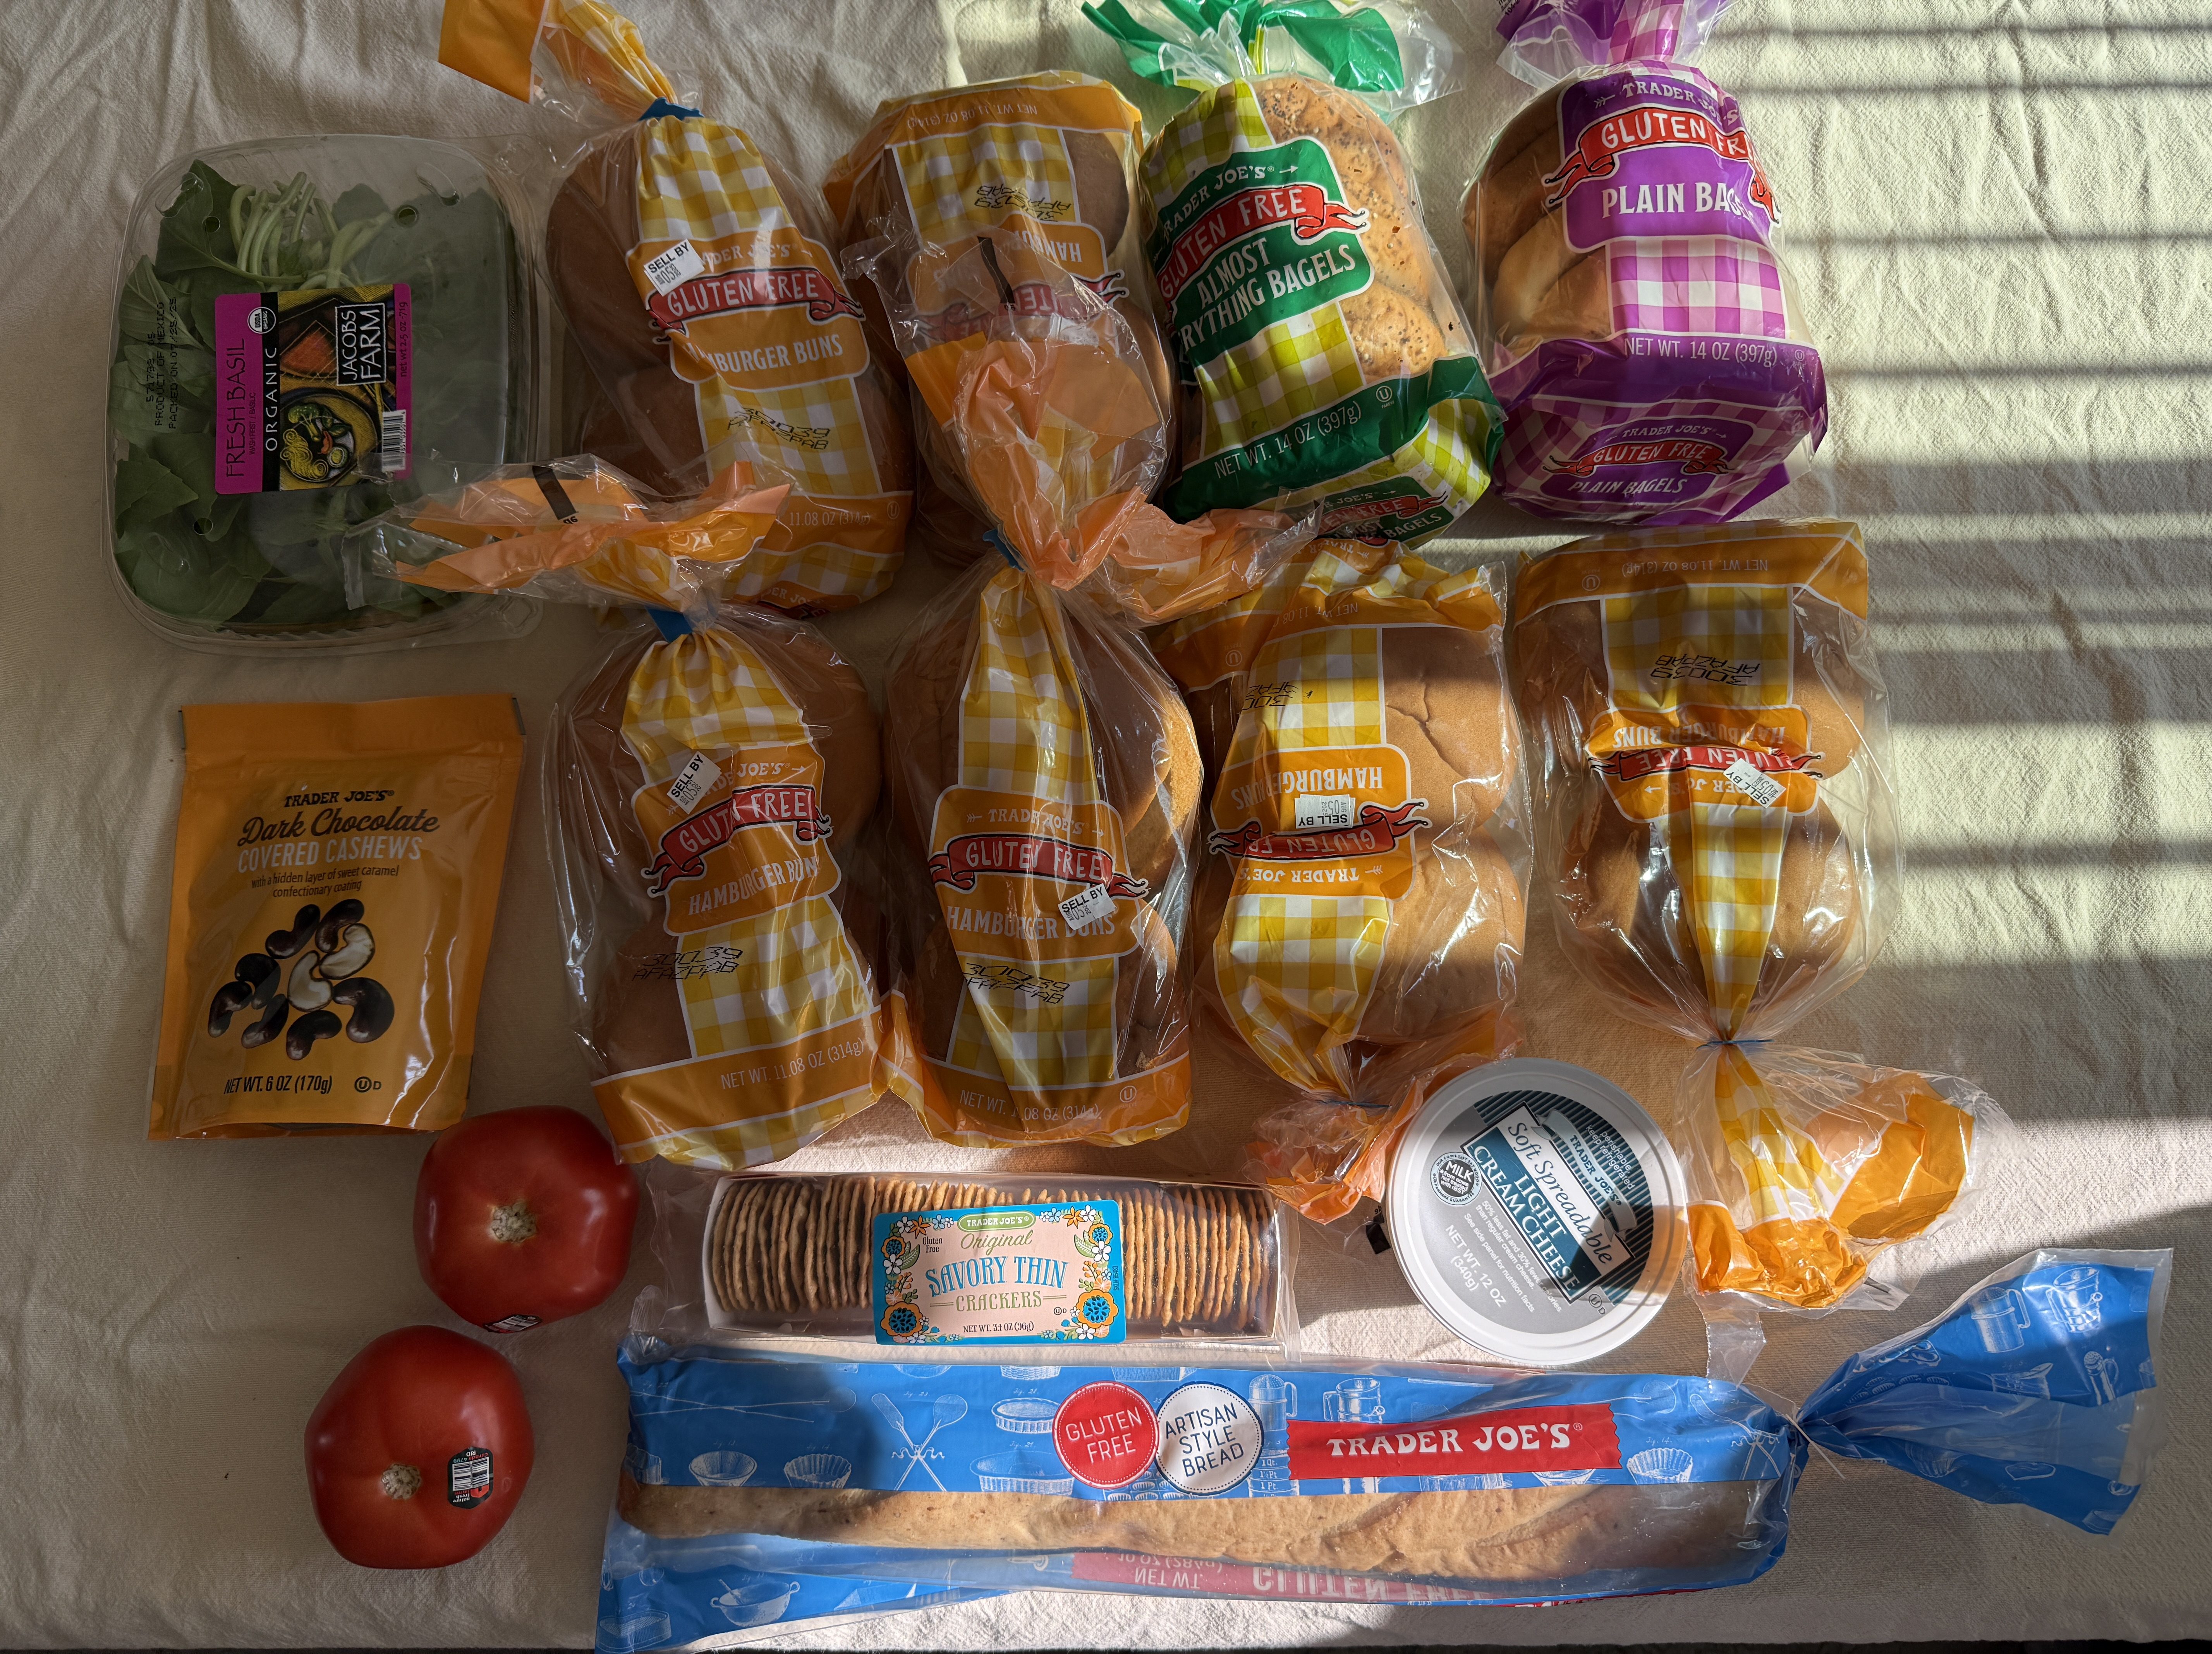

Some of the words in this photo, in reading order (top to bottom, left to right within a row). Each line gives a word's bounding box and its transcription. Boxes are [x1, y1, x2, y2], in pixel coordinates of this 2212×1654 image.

[1622, 81, 1696, 104] TRADER
[907, 115, 940, 130] (314g)
[945, 111, 958, 124] OZ
[1017, 103, 1037, 115] NET
[1601, 112, 1706, 148] GLUTEN
[1602, 183, 1685, 219] PLAIN
[648, 253, 675, 274] SELL
[675, 242, 690, 257] BY
[1161, 213, 1226, 298] GLUTEN
[1238, 189, 1306, 226] FREE
[1197, 237, 1270, 309] ALMOST
[1266, 244, 1355, 298] BAGELS
[668, 277, 754, 317] GLUTEN
[766, 274, 819, 300] FREE
[400, 321, 406, 332] oz
[157, 351, 164, 366] OF
[341, 310, 357, 380] JACOBS
[360, 309, 382, 379] FARM
[400, 349, 407, 360] wt
[793, 334, 843, 363] BUNS
[1625, 338, 1654, 357] NET
[1657, 340, 1683, 358] WT.
[1690, 341, 1706, 359] 14
[1712, 342, 1729, 360] OZ
[1735, 343, 1777, 367] (397g)
[170, 362, 177, 376] ON
[226, 338, 246, 400] BASIL
[156, 373, 164, 426] PRODUCT
[169, 383, 178, 429] PACKED
[265, 347, 277, 451] ORGANIC
[227, 407, 245, 477] FRESH
[1214, 452, 1242, 479] NET
[1246, 445, 1272, 465] WT.
[1275, 436, 1292, 455] 14
[1295, 423, 1316, 442] OZ
[1318, 401, 1362, 436] (397g)
[1622, 426, 1672, 438] TRADER
[1593, 445, 1659, 463] GLUTEN
[1670, 444, 1712, 460] FREE
[1568, 480, 1622, 494] PLAIN
[1626, 479, 1687, 495] BAGELS
[1383, 513, 1442, 537] BAGELS
[1622, 561, 1657, 577] (314g)
[1662, 561, 1677, 571] OZ
[1682, 561, 1713, 570] 11.08
[1744, 559, 1768, 571] NET
[1613, 726, 1662, 748] BUNS
[284, 792, 339, 808] TRADER
[750, 791, 807, 818] FREE
[237, 811, 306, 847] Dark
[311, 806, 440, 837] Chocolate
[1298, 816, 1314, 826] BY
[1317, 814, 1348, 824] SELL
[238, 841, 319, 873] COVERED
[326, 836, 422, 863] CASHEWS
[1287, 829, 1376, 853] GLUTEN
[252, 877, 266, 888] with
[273, 874, 302, 884] hidden
[306, 871, 325, 884] layer
[328, 868, 337, 880] of
[338, 867, 359, 878] sweet
[362, 865, 399, 877] caramel
[1054, 848, 1103, 880] FREE
[1291, 868, 1360, 883] TRADER
[273, 884, 331, 897] confectionary
[334, 880, 362, 892] coating
[688, 863, 785, 915] HAMBURGER
[947, 906, 1059, 940] HAMBURGER
[721, 1071, 745, 1089] NET
[749, 1066, 770, 1084] WT.
[775, 1058, 805, 1080] 11.08
[808, 1051, 825, 1069] OZ
[828, 1038, 865, 1064] (314g)
[224, 1077, 242, 1094] NET
[243, 1076, 263, 1092] WT.
[266, 1076, 273, 1091] 6
[276, 1076, 292, 1091] OZ
[294, 1075, 332, 1094] (170g)
[1569, 1135, 1595, 1174] TRADER
[1601, 1144, 1635, 1190] refrigerated
[1446, 1161, 1473, 1182] MILK
[1508, 1122, 1541, 1160] Soft
[1534, 1160, 1612, 1264] Spreadable
[1514, 1174, 1568, 1238] LIGHT
[1474, 1146, 1525, 1216] CREAM
[1522, 1215, 1580, 1291] CHEESE
[1476, 1204, 1488, 1221] than
[1486, 1219, 1503, 1243] regular
[1501, 1243, 1518, 1264] cream
[960, 1230, 1034, 1255] Original
[1482, 1200, 1494, 1216] 50%
[1492, 1215, 1504, 1230] less
[1502, 1229, 1511, 1239] fat
[1508, 1239, 1520, 1253] and
[1518, 1251, 1530, 1268] 30%
[1528, 1265, 1543, 1285] fewer
[1542, 1287, 1561, 1312] calories
[925, 1256, 1009, 1297] SAVORY
[1014, 1257, 1069, 1289] THIN
[1446, 1225, 1467, 1248] NET
[1463, 1249, 1481, 1274] WT.
[1480, 1273, 1492, 1289] 12
[1490, 1288, 1506, 1308] OZ
[1450, 1256, 1479, 1291] (340g)
[1464, 1213, 1475, 1228] See
[1473, 1226, 1485, 1242] side
[1482, 1242, 1499, 1260] panel
[1496, 1259, 1505, 1270] for
[1503, 1269, 1523, 1296] nutrition
[1521, 1295, 1535, 1313] facts
[956, 1291, 1042, 1311] CRACKERS
[979, 1324, 991, 1332] WT.
[1014, 1321, 1034, 1331] (96g)
[1065, 1407, 1142, 1442] GLUTEN
[1165, 1402, 1238, 1439] ARTISAN
[1087, 1434, 1136, 1464] FREE
[1179, 1425, 1236, 1455] STYLE
[1326, 1429, 1463, 1456] TRADER
[1472, 1423, 1570, 1451] JOE'S
[1183, 1442, 1244, 1477] BREAD
